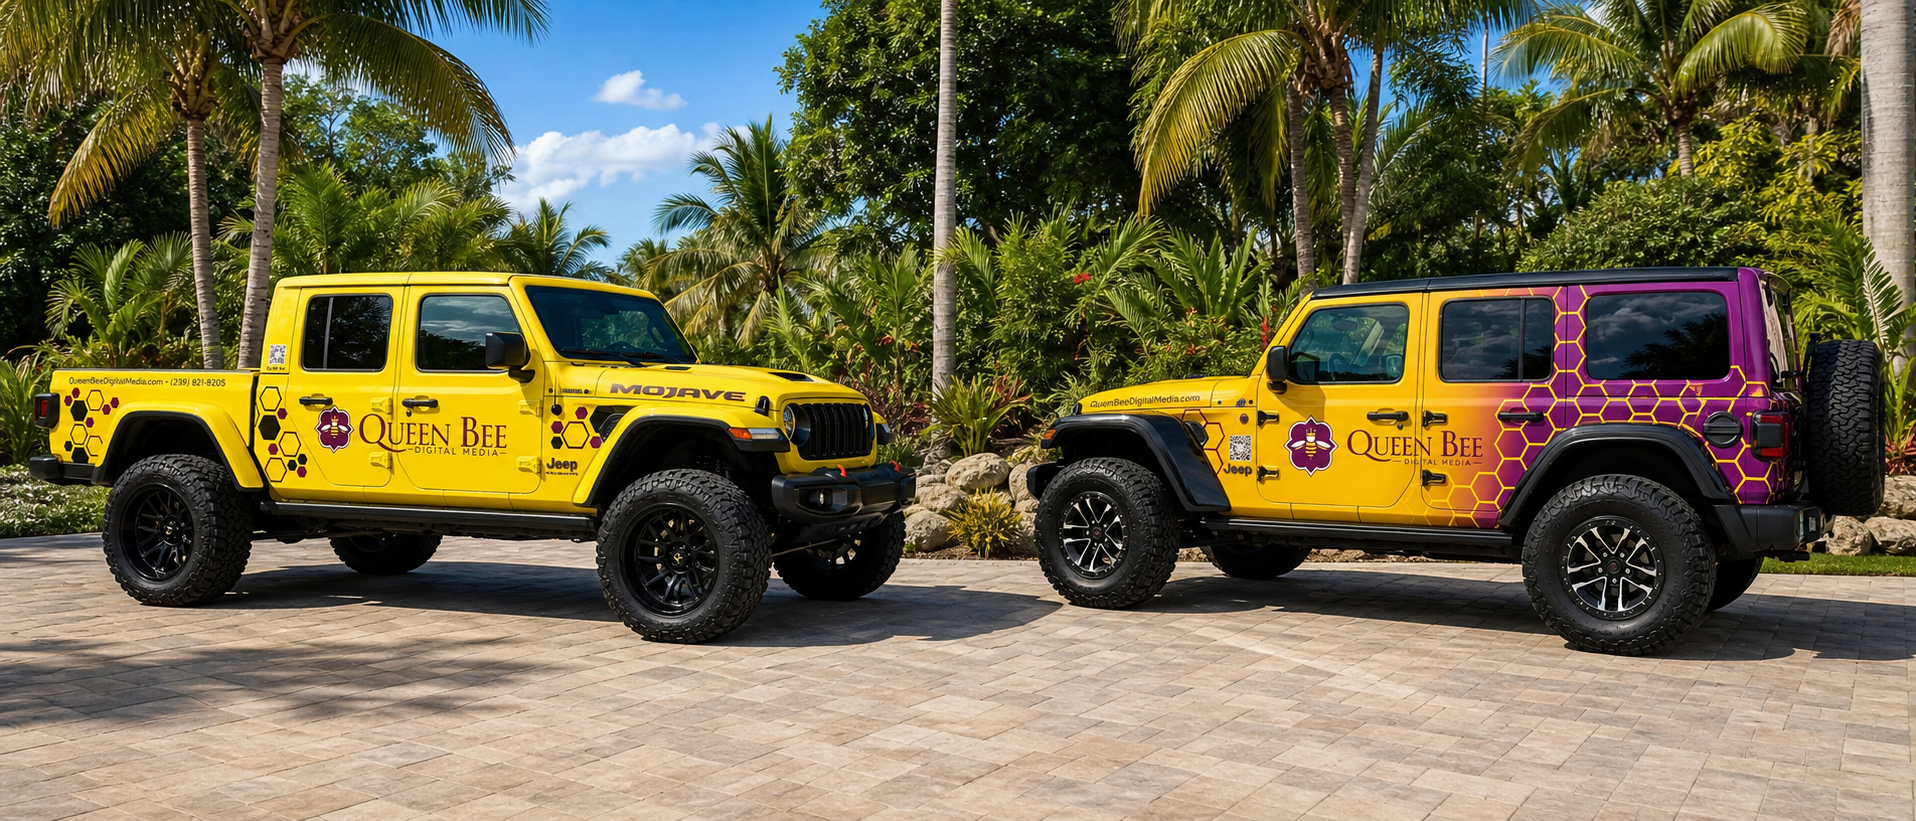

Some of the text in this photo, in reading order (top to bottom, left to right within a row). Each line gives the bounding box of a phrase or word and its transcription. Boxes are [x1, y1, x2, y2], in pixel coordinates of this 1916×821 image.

[170, 378, 190, 387] (239)
[610, 383, 746, 402] MOJAVE
[460, 416, 507, 449] BEE
[1440, 430, 1484, 458] BEE
[414, 446, 499, 457] DIGITAL MEDIA
[546, 457, 578, 472] Jeep
[1404, 458, 1471, 467] DIGITAL MEDIA
[1223, 463, 1253, 477] Jeep
